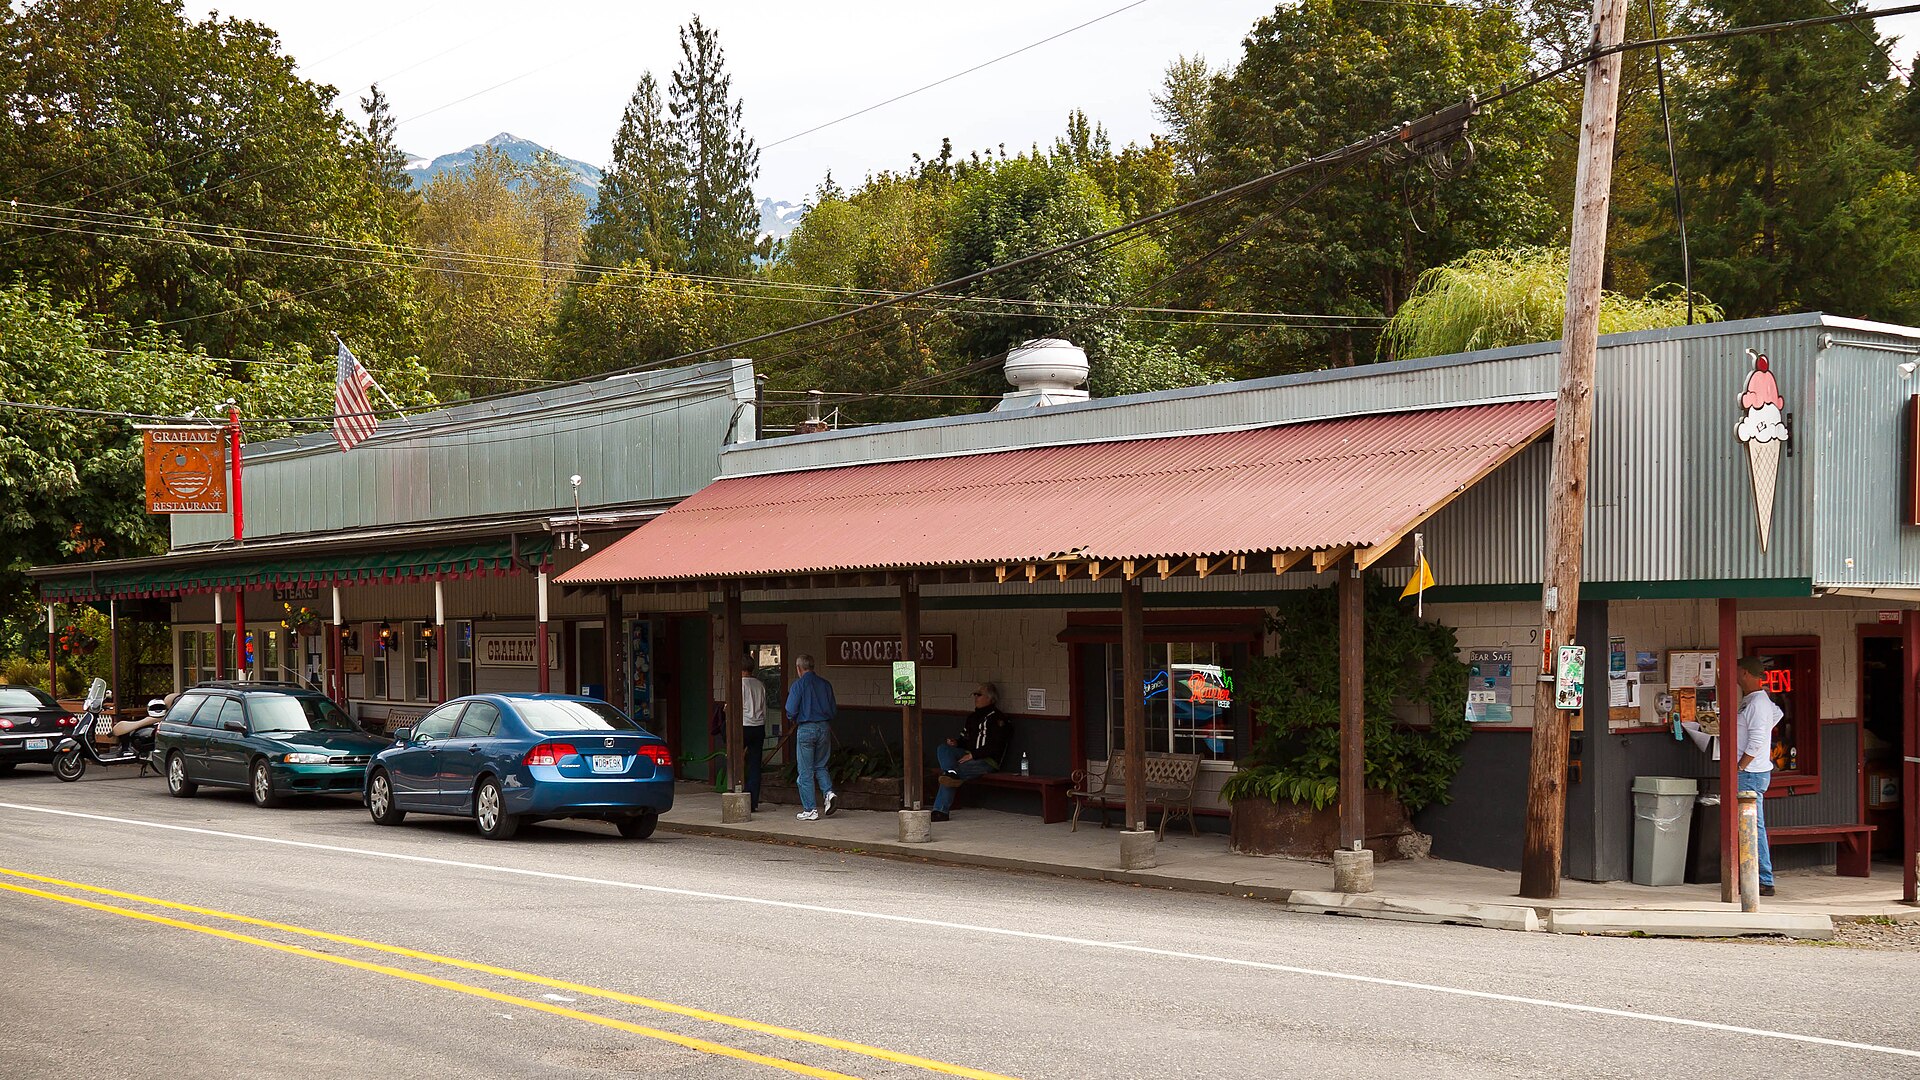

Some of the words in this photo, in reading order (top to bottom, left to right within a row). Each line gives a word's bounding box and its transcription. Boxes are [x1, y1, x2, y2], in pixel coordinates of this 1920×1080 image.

[153, 502, 222, 511] RESTAURANT
[1529, 629, 1537, 644] 9
[487, 639, 538, 661] GRAHAM'
[841, 641, 934, 660] GROCERS
[1188, 673, 1230, 704] Rainier
[1761, 669, 1791, 692] PEN
